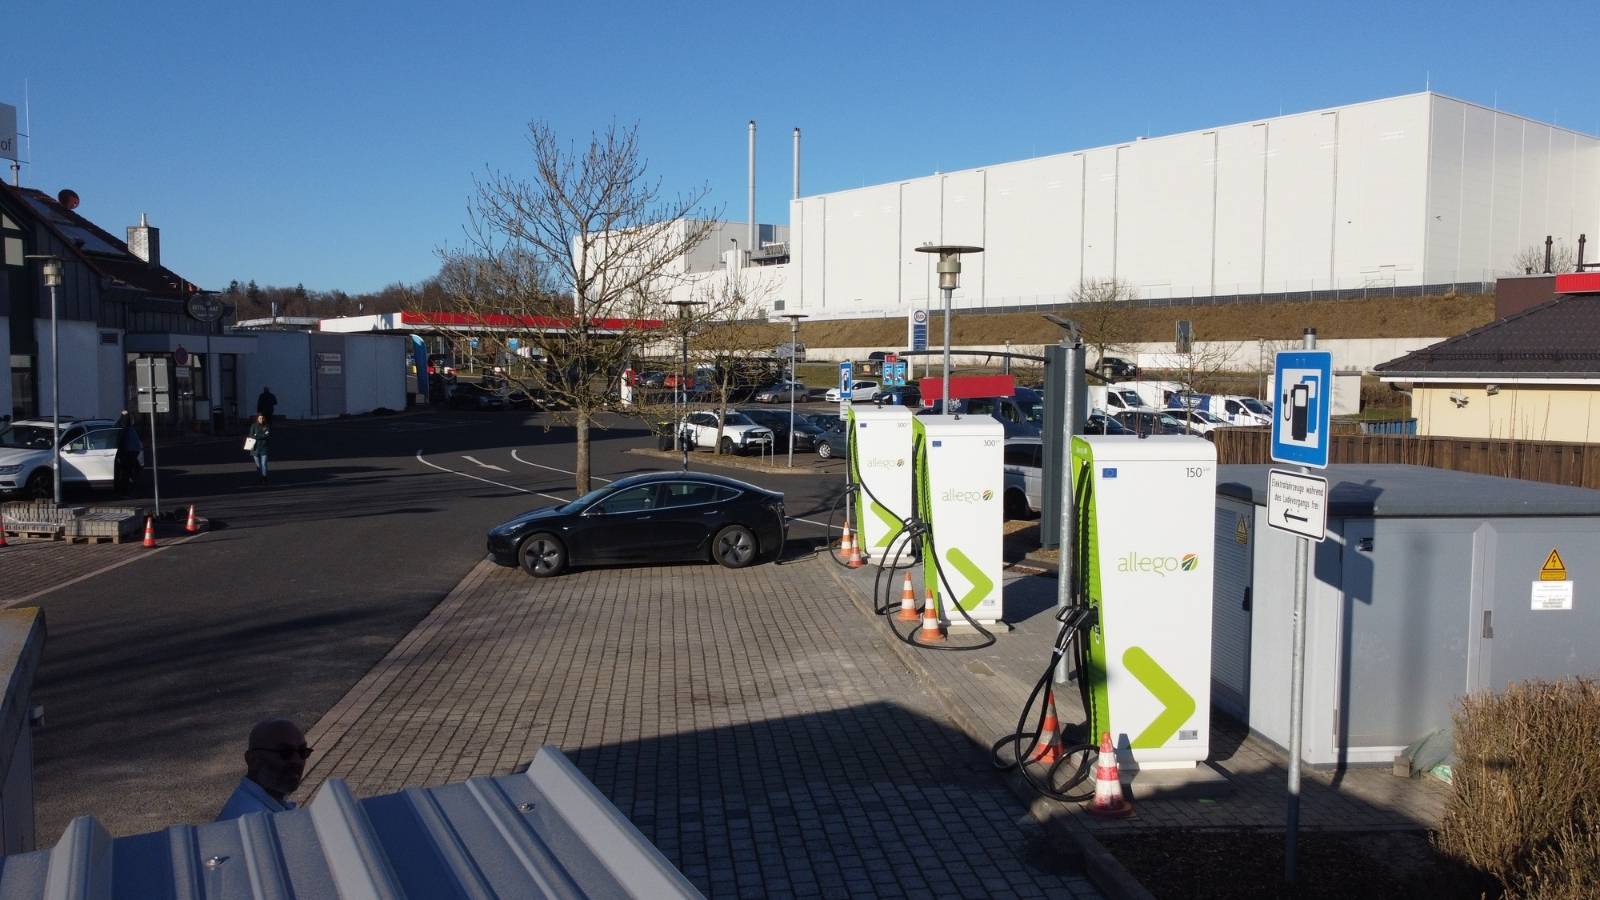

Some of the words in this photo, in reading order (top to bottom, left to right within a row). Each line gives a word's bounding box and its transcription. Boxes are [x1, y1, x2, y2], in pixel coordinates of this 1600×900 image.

[1186, 467, 1203, 478] 150
[942, 487, 981, 504] allego
[1117, 551, 1179, 577] allego
